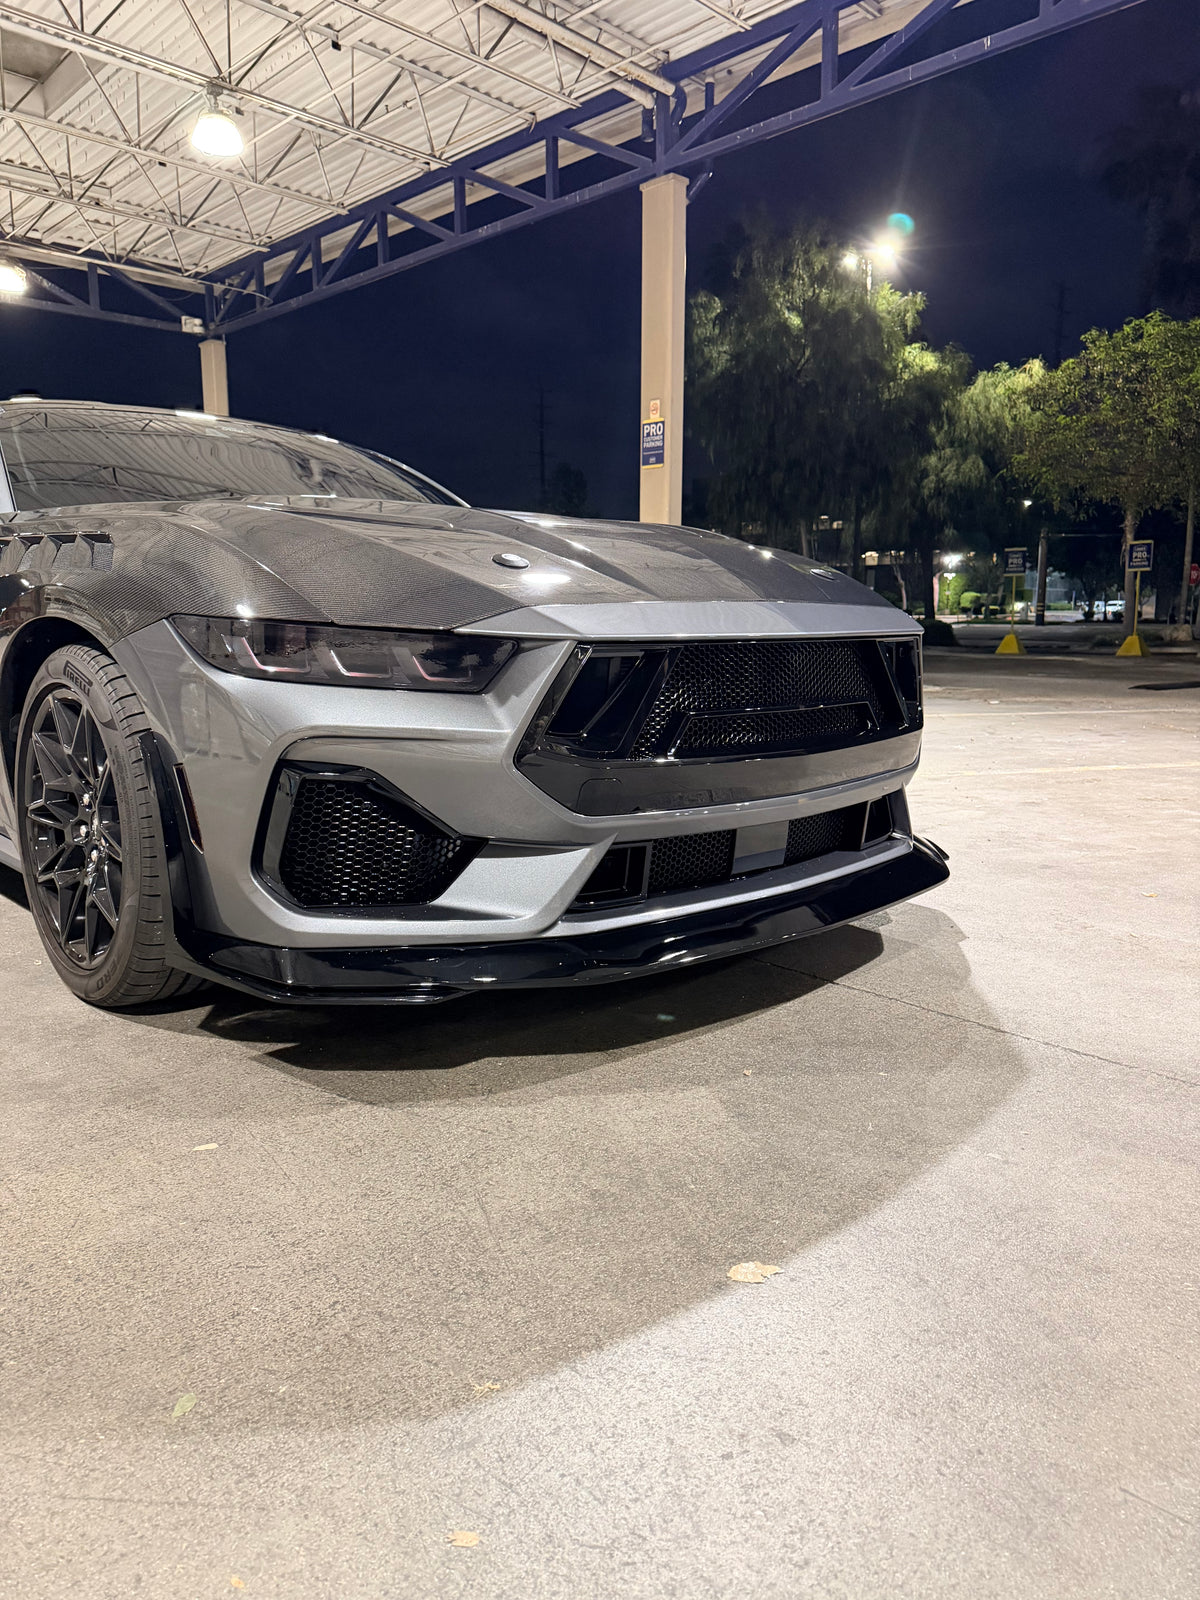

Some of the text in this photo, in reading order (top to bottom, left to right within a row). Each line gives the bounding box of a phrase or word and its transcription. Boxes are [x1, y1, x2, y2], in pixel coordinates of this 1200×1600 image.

[643, 422, 664, 437] PRO
[643, 440, 664, 449] PARKING
[1132, 551, 1147, 559] PRO
[63, 660, 93, 697] PIRELLI
